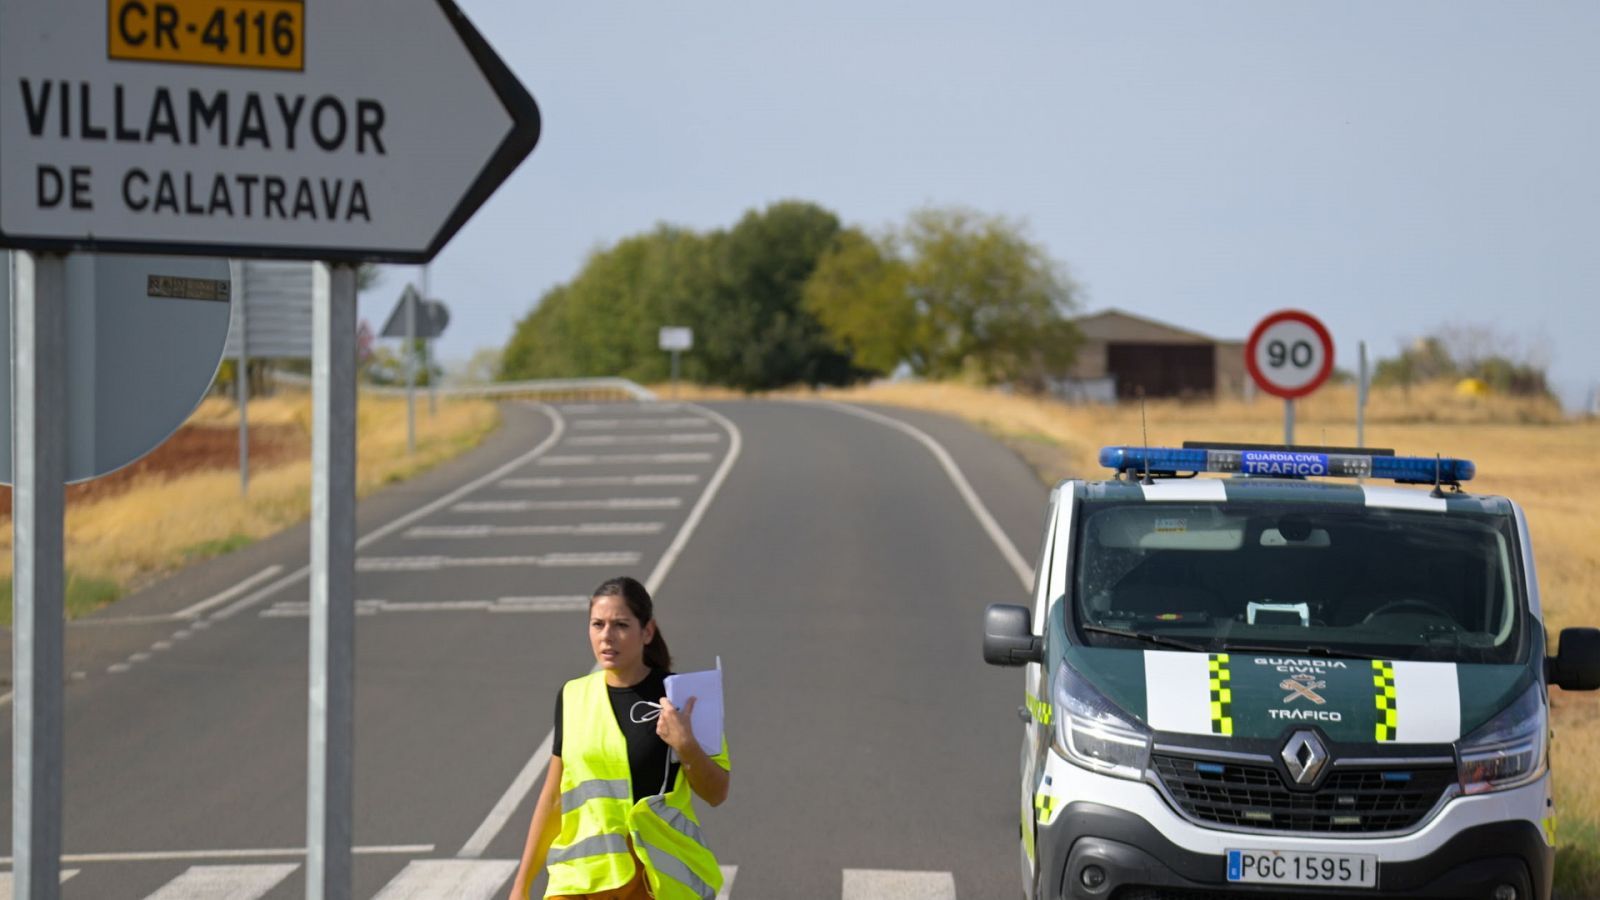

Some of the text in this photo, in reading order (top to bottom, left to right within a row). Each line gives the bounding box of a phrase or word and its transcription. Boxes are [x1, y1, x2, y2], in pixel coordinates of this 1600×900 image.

[119, 2, 295, 56] CR-4116
[19, 77, 387, 155] VILLAMAYOR
[36, 164, 372, 222] DE CALATRAVA
[1267, 340, 1313, 368] 90
[1246, 453, 1294, 461] GUARDIA
[1246, 461, 1324, 475] TRAFICO
[1254, 658, 1347, 669] GUARDIA
[1276, 666, 1326, 674] CIVIL
